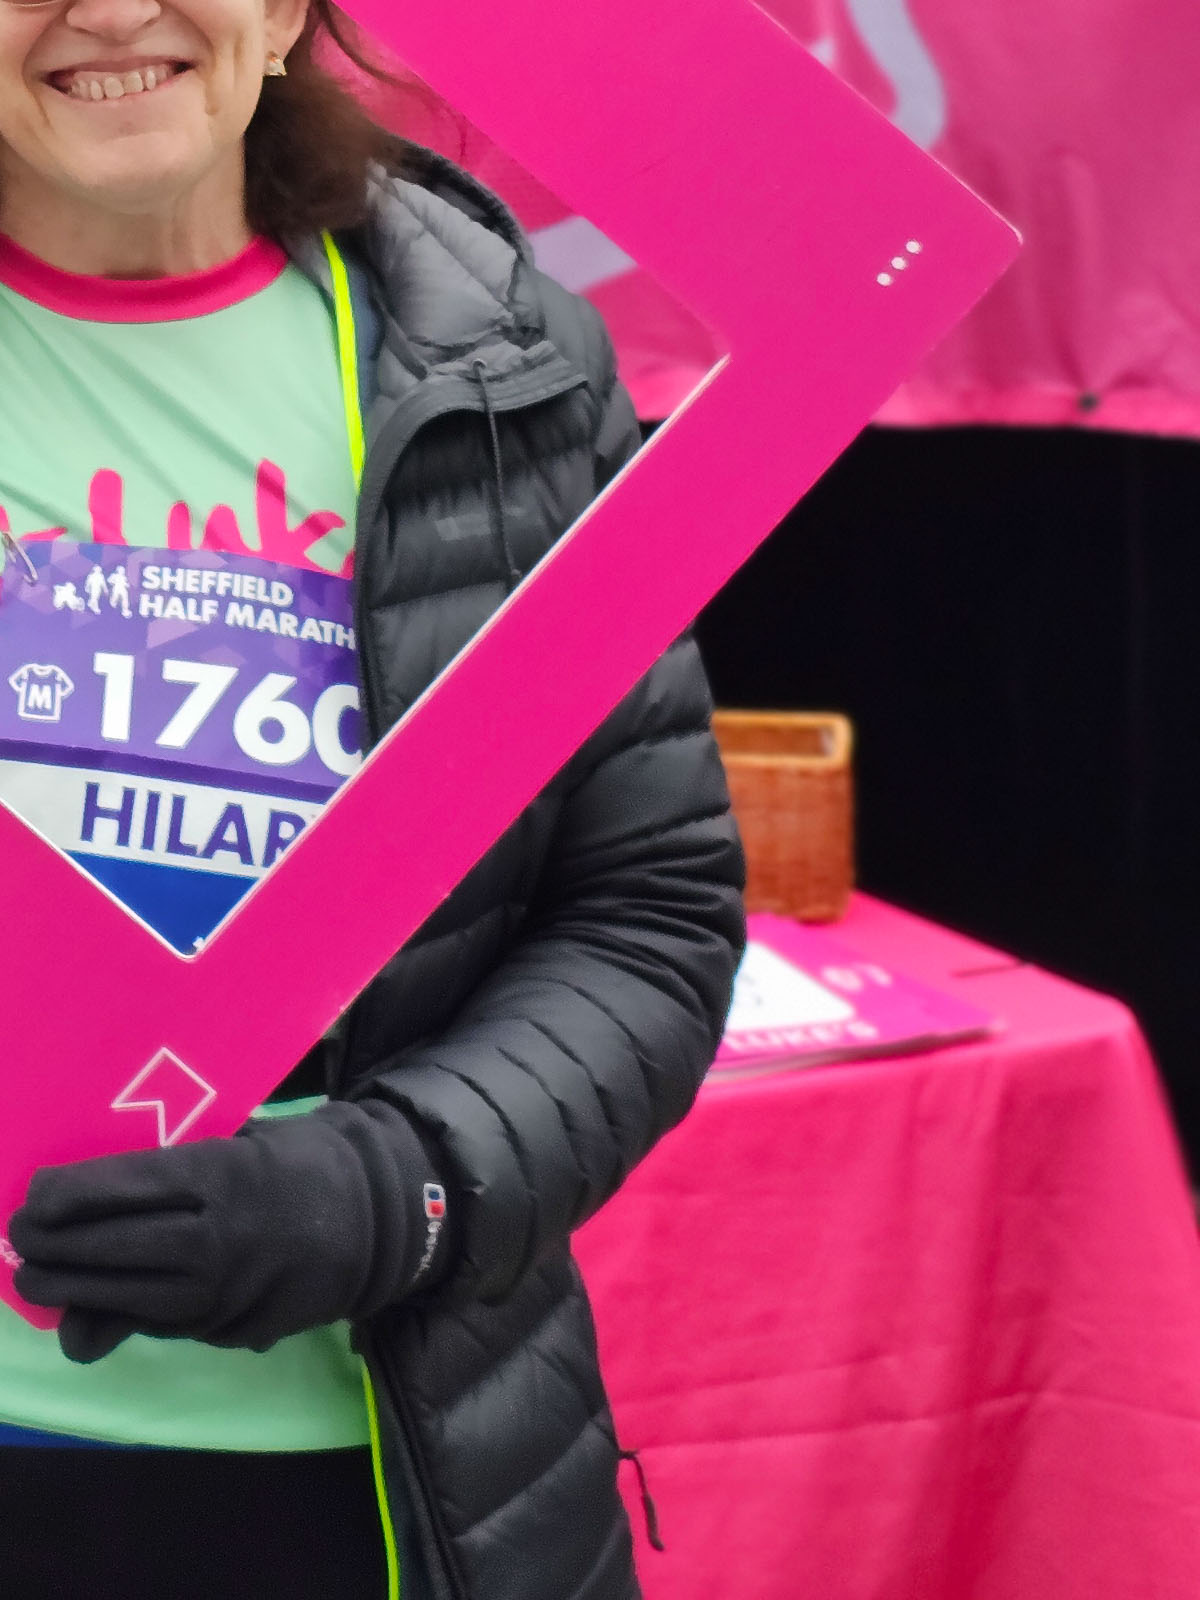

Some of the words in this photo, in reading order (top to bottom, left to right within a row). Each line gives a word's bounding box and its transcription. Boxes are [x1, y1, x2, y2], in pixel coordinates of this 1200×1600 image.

[142, 565, 294, 608] SHEFFIELD
[139, 595, 219, 625] HALF
[224, 602, 356, 650] MARATH
[81, 782, 308, 870] HILAR
